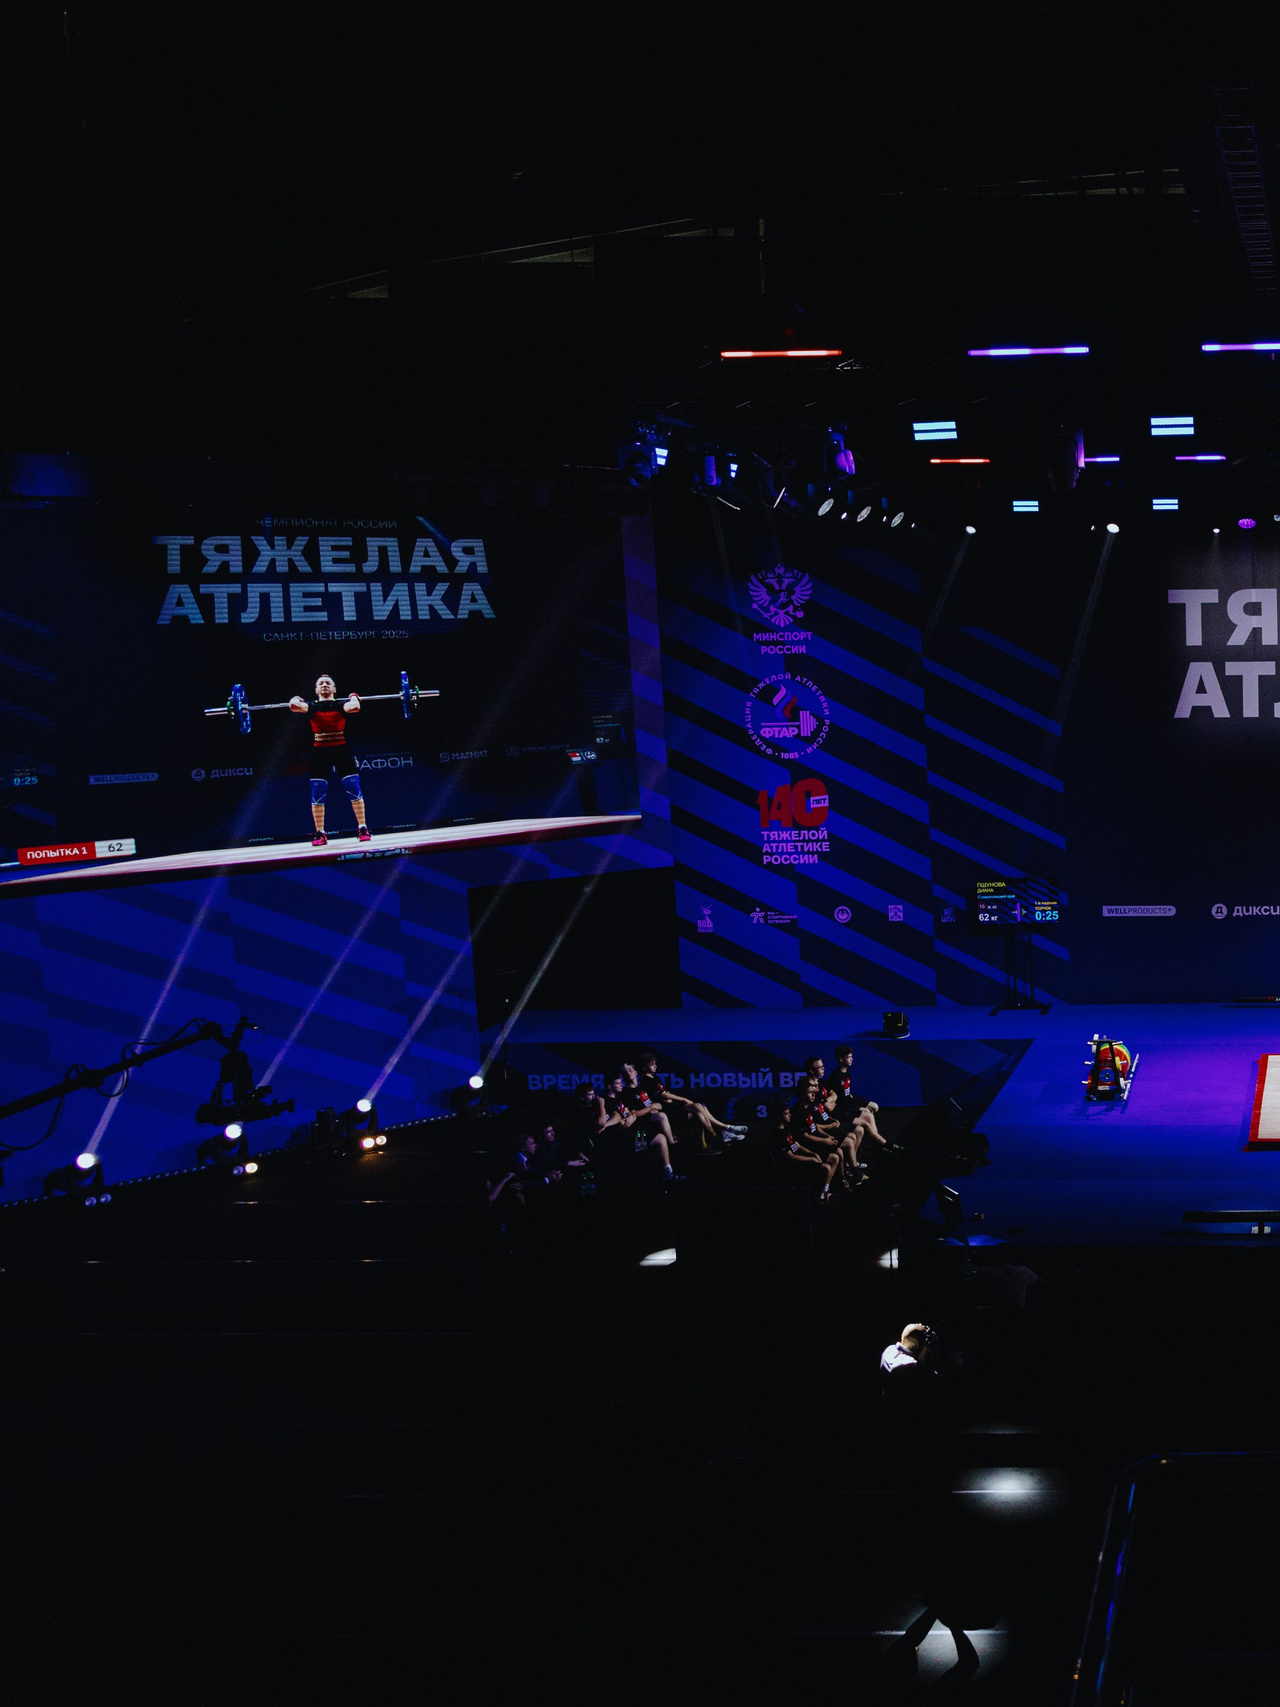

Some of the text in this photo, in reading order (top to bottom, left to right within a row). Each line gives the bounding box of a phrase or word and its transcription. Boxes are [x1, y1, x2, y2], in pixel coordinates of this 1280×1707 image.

[256, 517, 398, 529] ЧЕМПИОНАТ РОССИИ
[153, 535, 489, 574] ТЯЖЕЛАЯ
[156, 582, 497, 625] АТЛЕТИКА
[263, 630, 378, 642] САНКТ-ПЕТЕРБУРГ
[753, 631, 813, 642] МИНСПОРТ
[761, 645, 806, 655] РОССИИ
[744, 672, 830, 755] ФЕДЕРАЦИЯ ТЯЖЕЛОЙ АТЛЕТИКИ РОССИИ
[760, 726, 799, 738] ФТАР
[780, 751, 799, 759] 1885
[13, 776, 38, 786] 0:25
[756, 778, 829, 828] 140
[761, 827, 828, 840] ТЯЖЕЛОЙ
[27, 846, 88, 860] ПОПЫТКА 1
[108, 842, 123, 852] 62
[762, 842, 830, 853] АТЛЕТИКЕ
[763, 854, 818, 865] РОССИИ
[978, 913, 989, 921] 62
[1035, 911, 1059, 920] 0:25
[690, 1067, 773, 1089] НОВЫЙ
